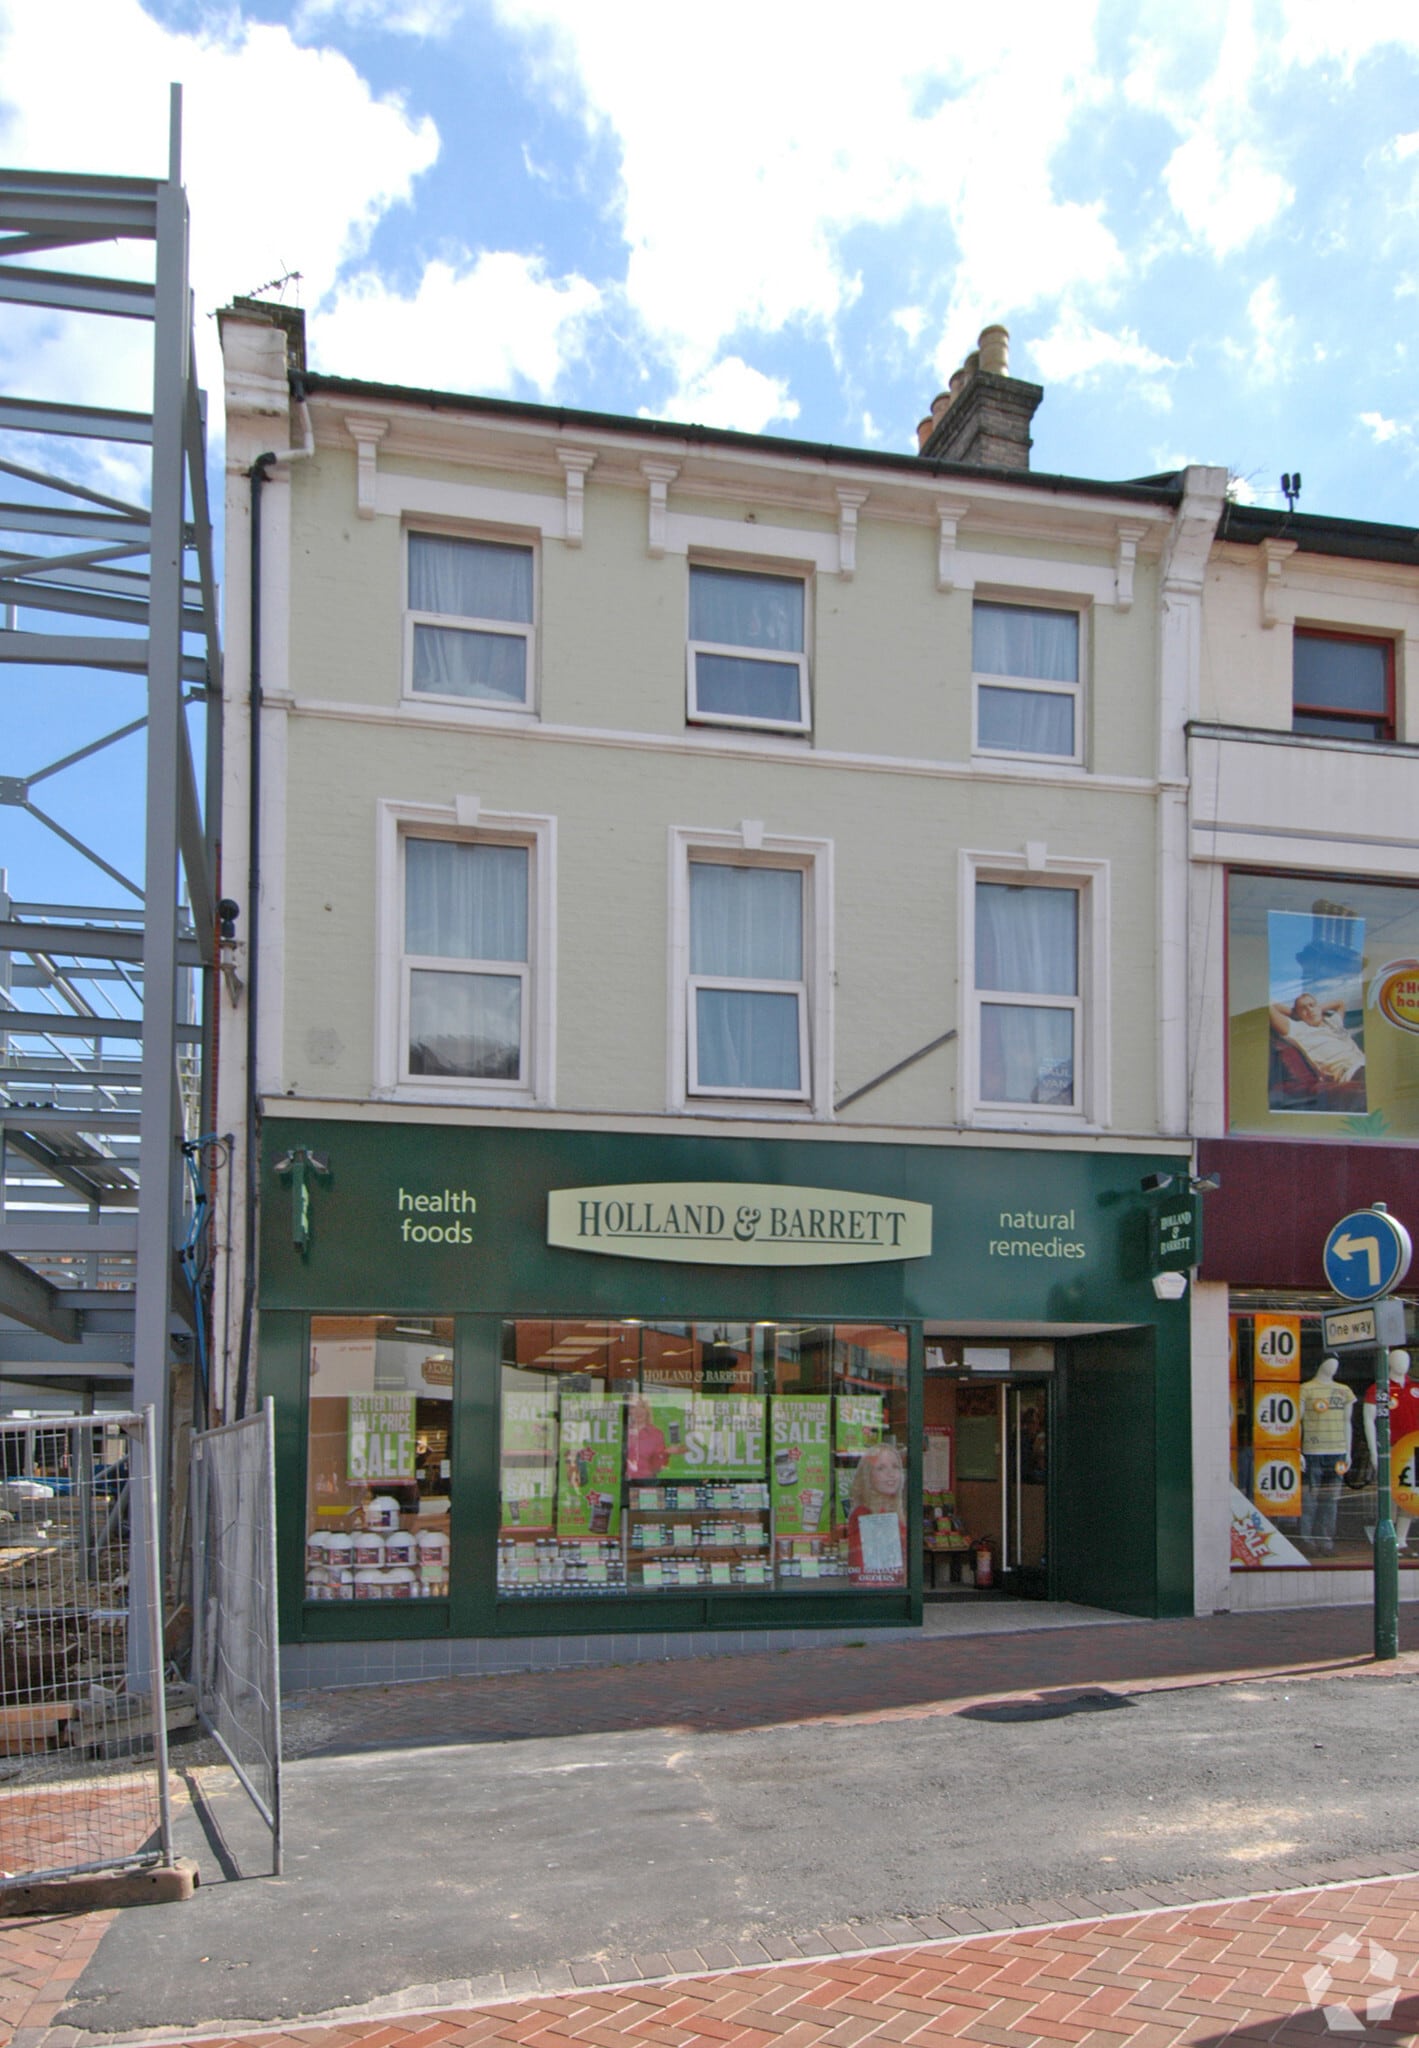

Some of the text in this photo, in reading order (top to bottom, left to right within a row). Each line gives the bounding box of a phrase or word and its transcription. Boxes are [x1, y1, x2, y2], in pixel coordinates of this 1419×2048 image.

[398, 1187, 476, 1213] health
[577, 1200, 907, 1246] HOLLAND & BARRETT
[999, 1208, 1075, 1230] natural
[1160, 1211, 1192, 1231] HOLLAND
[400, 1218, 473, 1244] foods
[1171, 1226, 1180, 1239] &
[989, 1236, 1086, 1258] remedies
[1160, 1236, 1191, 1255] BARRETT
[1329, 1320, 1373, 1336] One way
[1261, 1331, 1294, 1355] £10
[643, 1369, 693, 1382] HOLLAND
[705, 1370, 753, 1383] BARRETT
[685, 1400, 763, 1417] BETTER THAN
[841, 1408, 877, 1423] SALE
[1260, 1399, 1293, 1423] £10
[380, 1413, 411, 1432] PRICE
[563, 1420, 619, 1443] SALE
[722, 1416, 763, 1432] PRICE
[774, 1421, 828, 1443] SALE
[351, 1433, 411, 1477] SALE
[685, 1431, 763, 1465] SALE
[1260, 1465, 1295, 1491] £10
[1231, 1518, 1270, 1558] SALE
